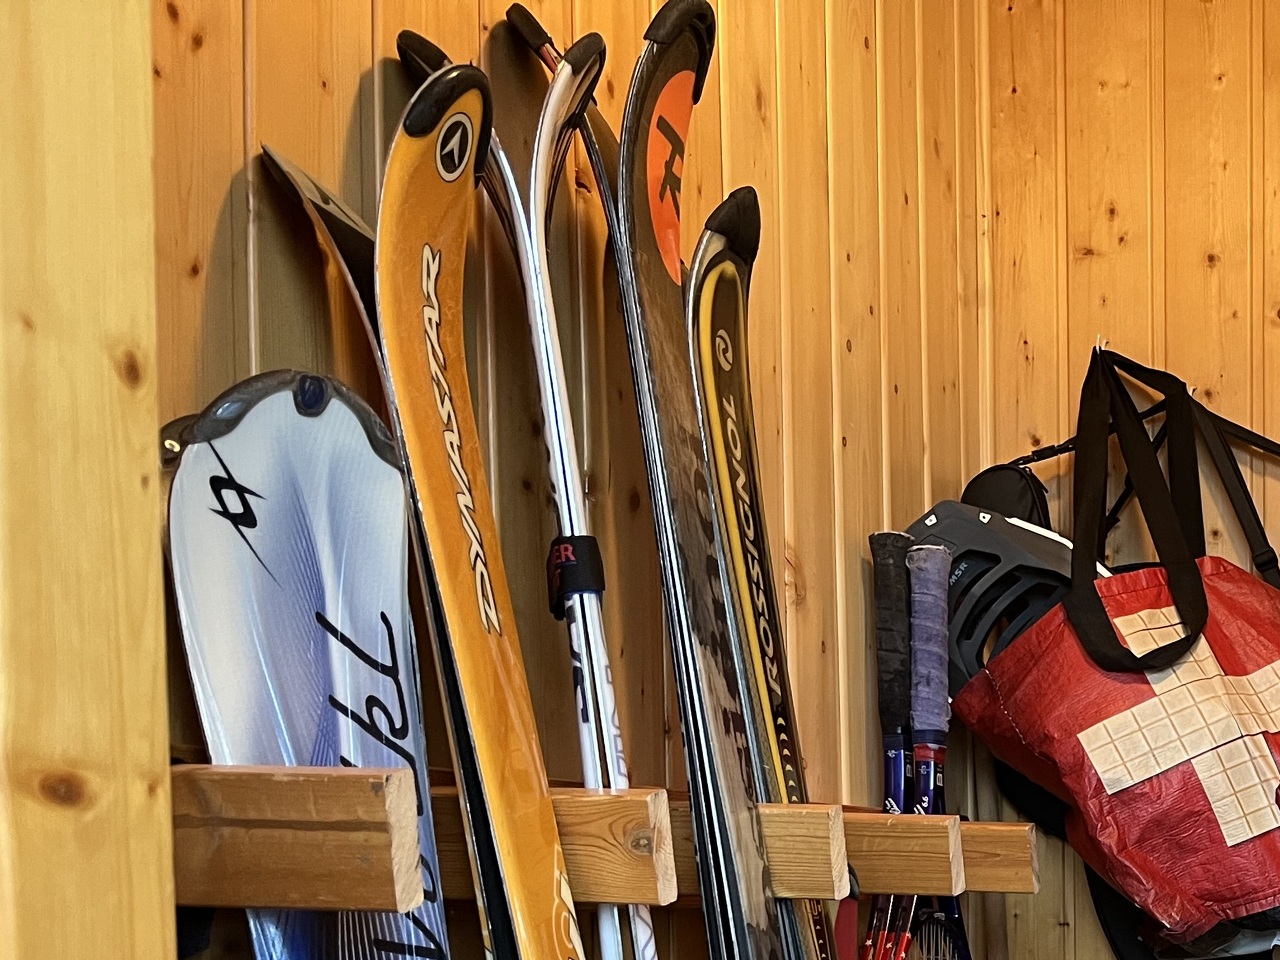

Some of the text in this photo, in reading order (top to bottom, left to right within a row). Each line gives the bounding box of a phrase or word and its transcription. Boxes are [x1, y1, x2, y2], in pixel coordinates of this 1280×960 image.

[421, 243, 502, 635] DYNASTAR
[722, 394, 785, 695] ROSSIGNOL
[948, 561, 970, 586] MSR
